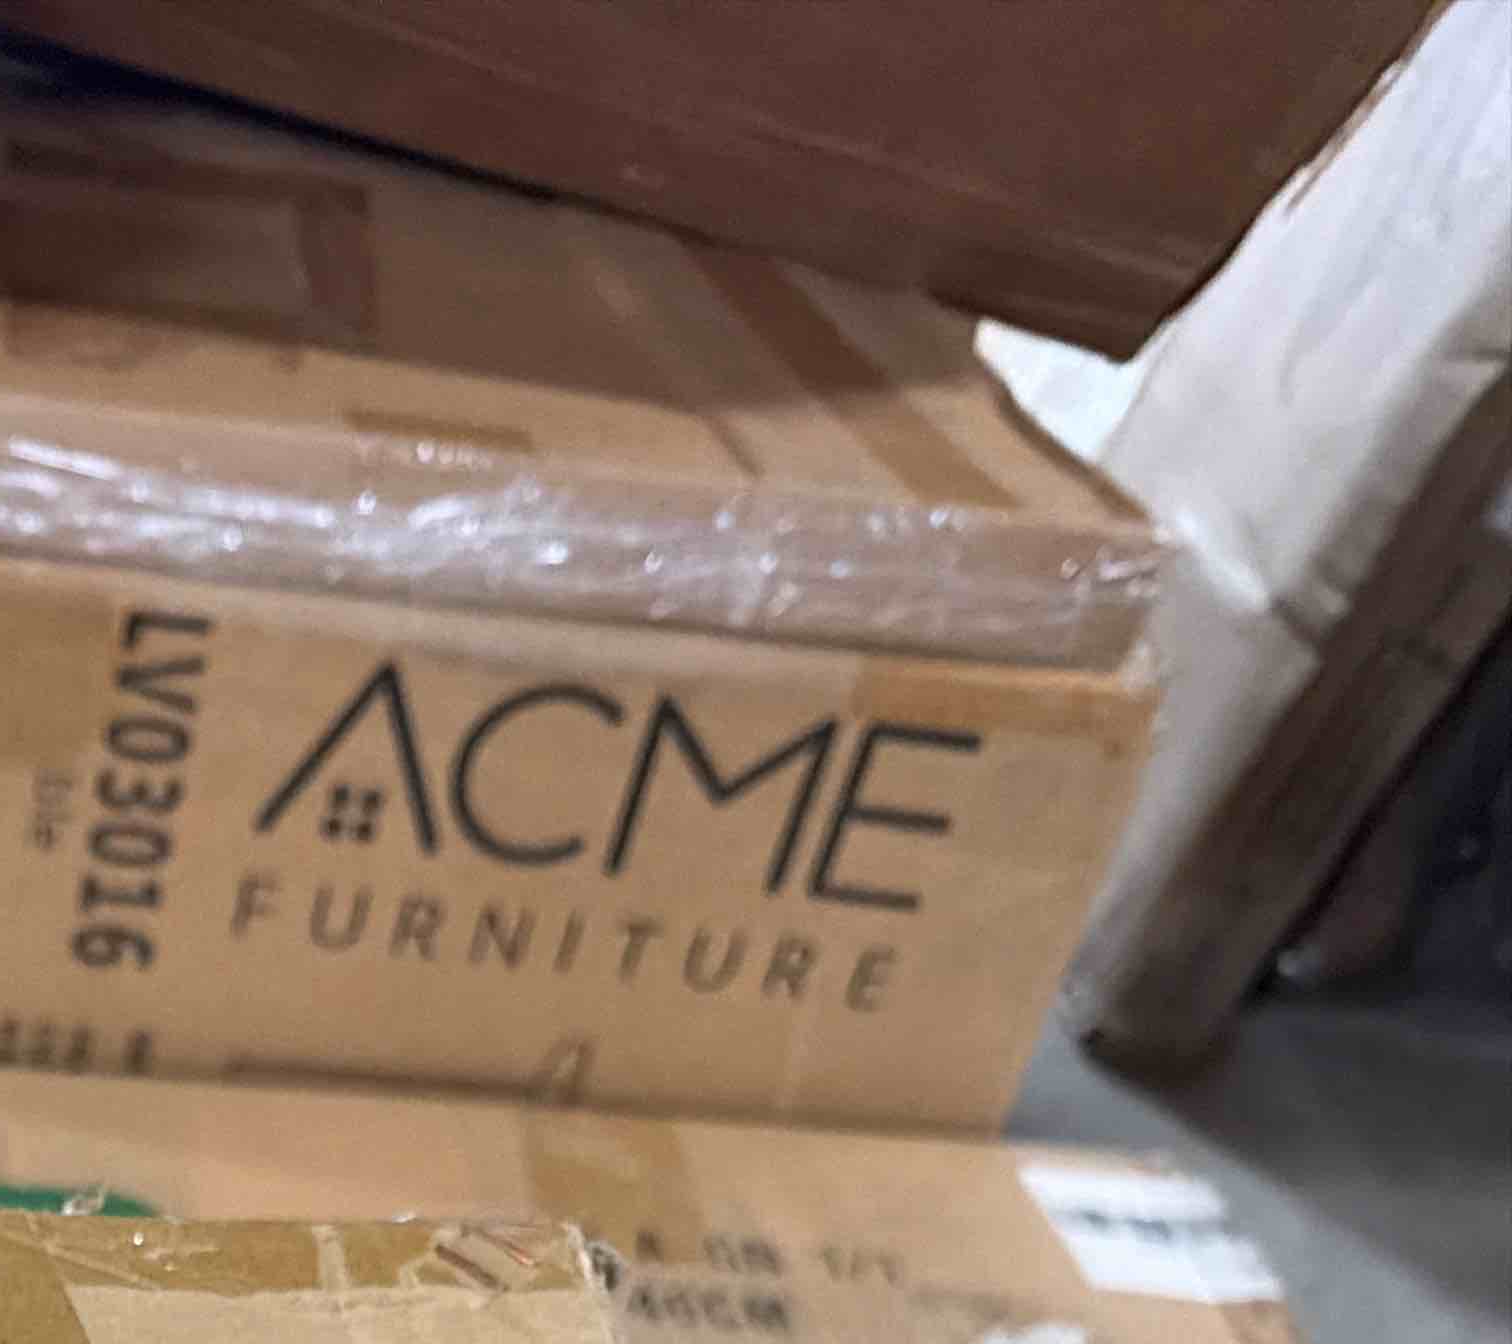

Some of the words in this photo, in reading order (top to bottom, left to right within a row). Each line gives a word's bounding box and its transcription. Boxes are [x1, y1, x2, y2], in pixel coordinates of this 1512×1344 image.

[71, 608, 217, 972] LV03016
[254, 659, 982, 911] ACME
[230, 875, 900, 1013] FURNITURE
